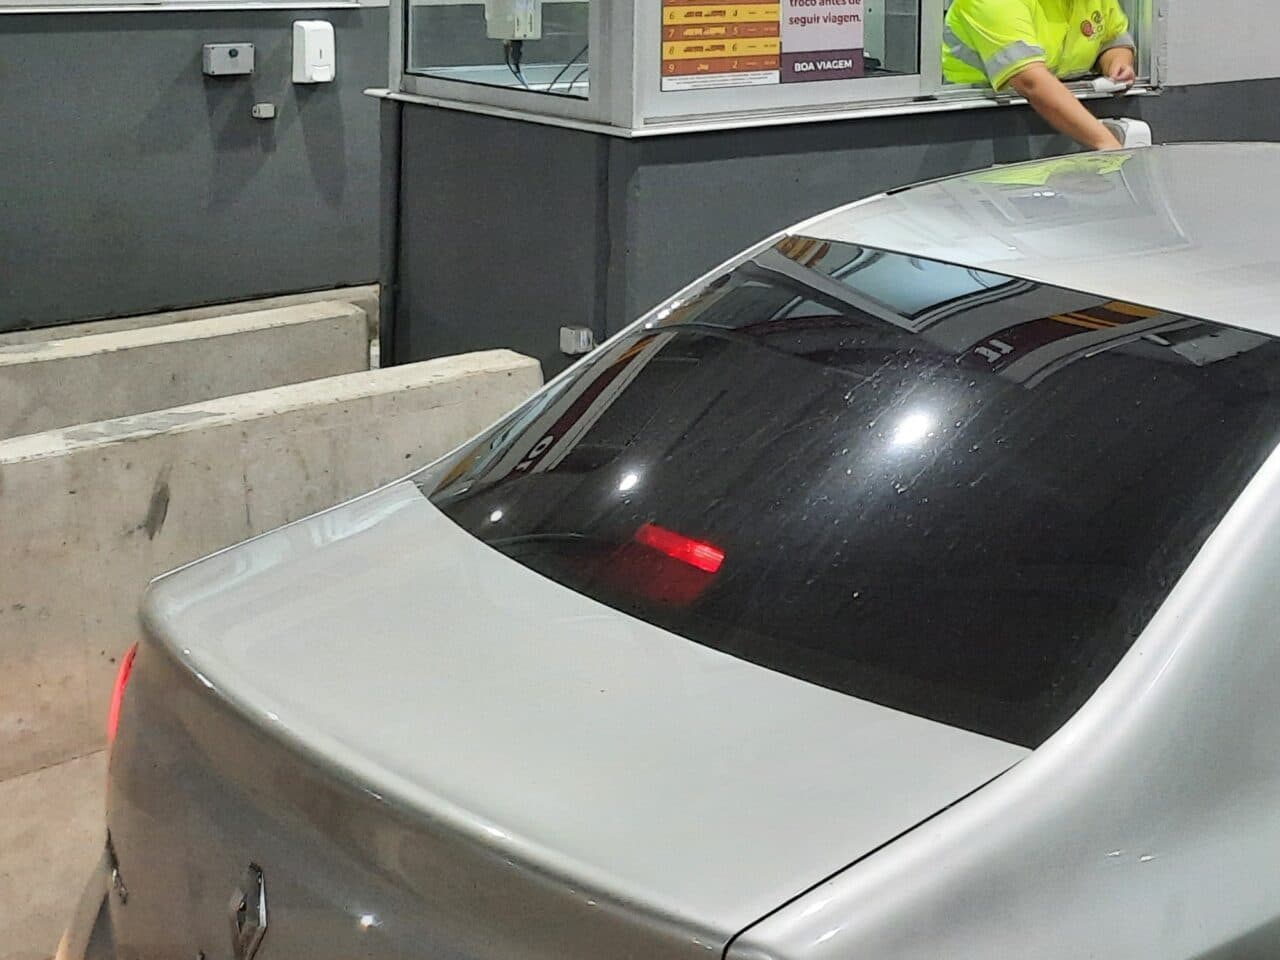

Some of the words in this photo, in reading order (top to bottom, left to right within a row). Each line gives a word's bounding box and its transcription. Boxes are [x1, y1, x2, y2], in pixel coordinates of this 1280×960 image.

[788, 13, 820, 27] seguir
[822, 12, 861, 25] viagem.
[794, 61, 815, 72] BOA
[816, 59, 852, 70] VIAGEM
